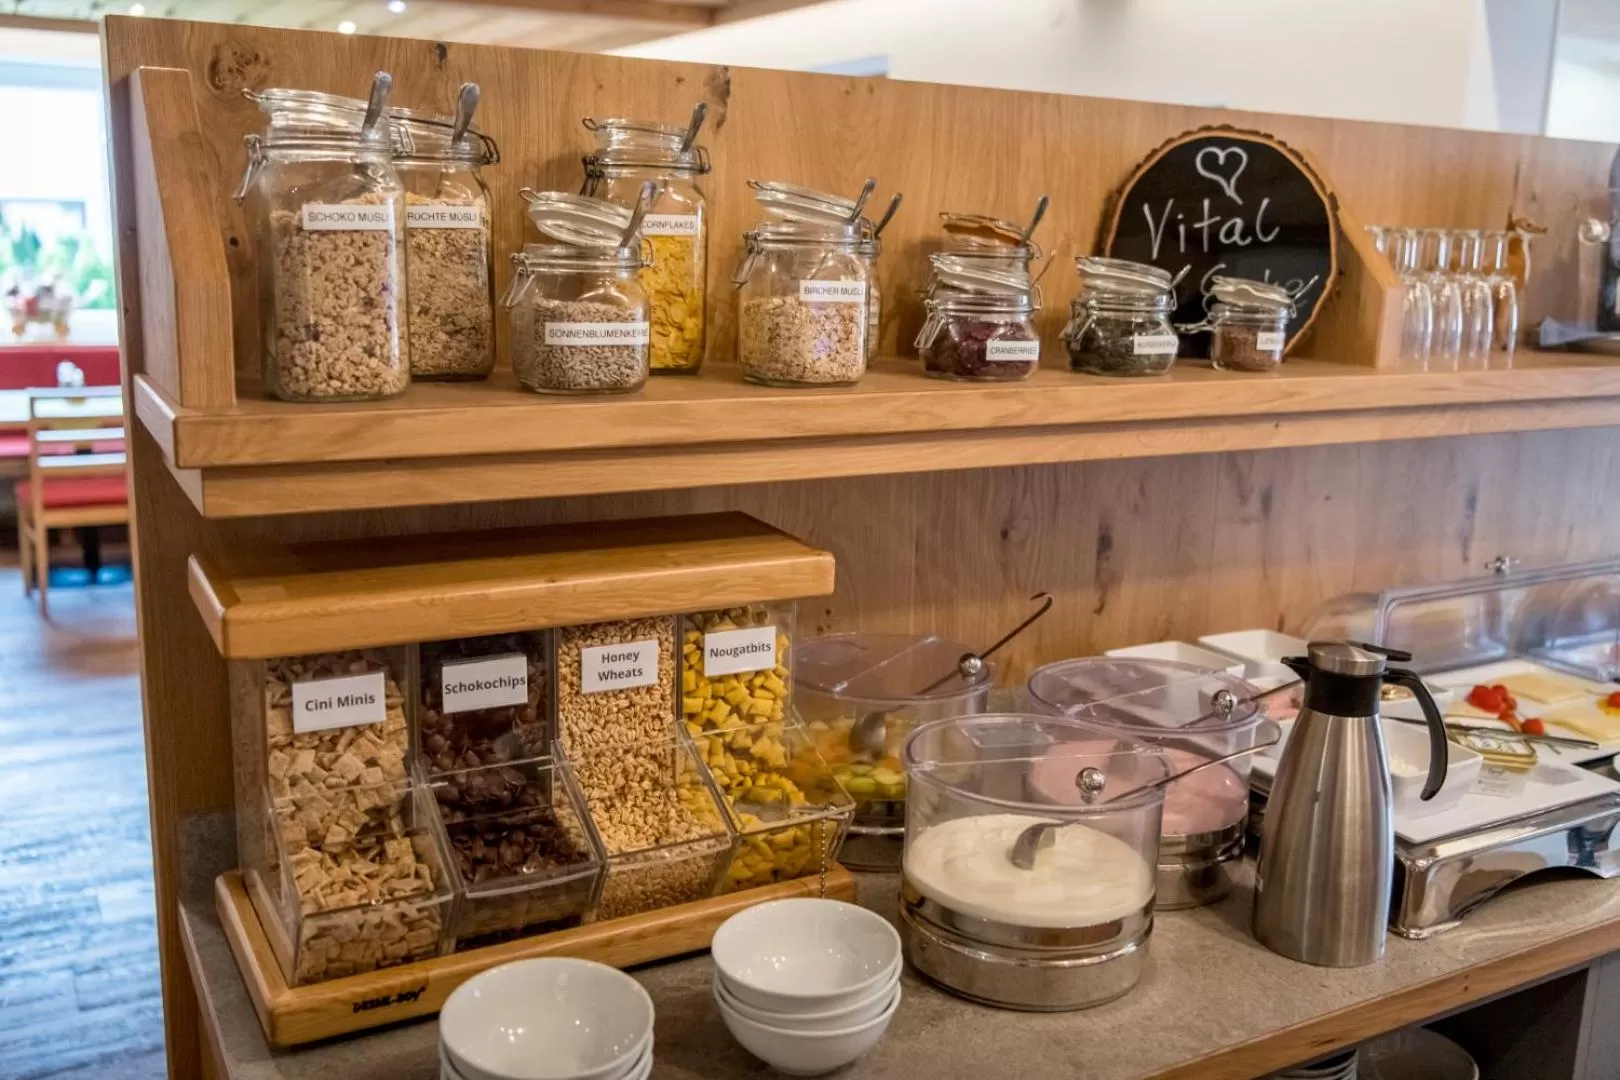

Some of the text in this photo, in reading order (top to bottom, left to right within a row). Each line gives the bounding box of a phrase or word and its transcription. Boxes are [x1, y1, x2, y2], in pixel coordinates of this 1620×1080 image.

[307, 211, 356, 222] SCHOKO
[1143, 198, 1280, 261] Vital
[601, 651, 641, 664] Honey
[709, 641, 772, 658] Nougatbits
[598, 667, 644, 682] Wheats
[444, 675, 527, 695] Schokochips
[305, 692, 376, 712] Cini Minis
